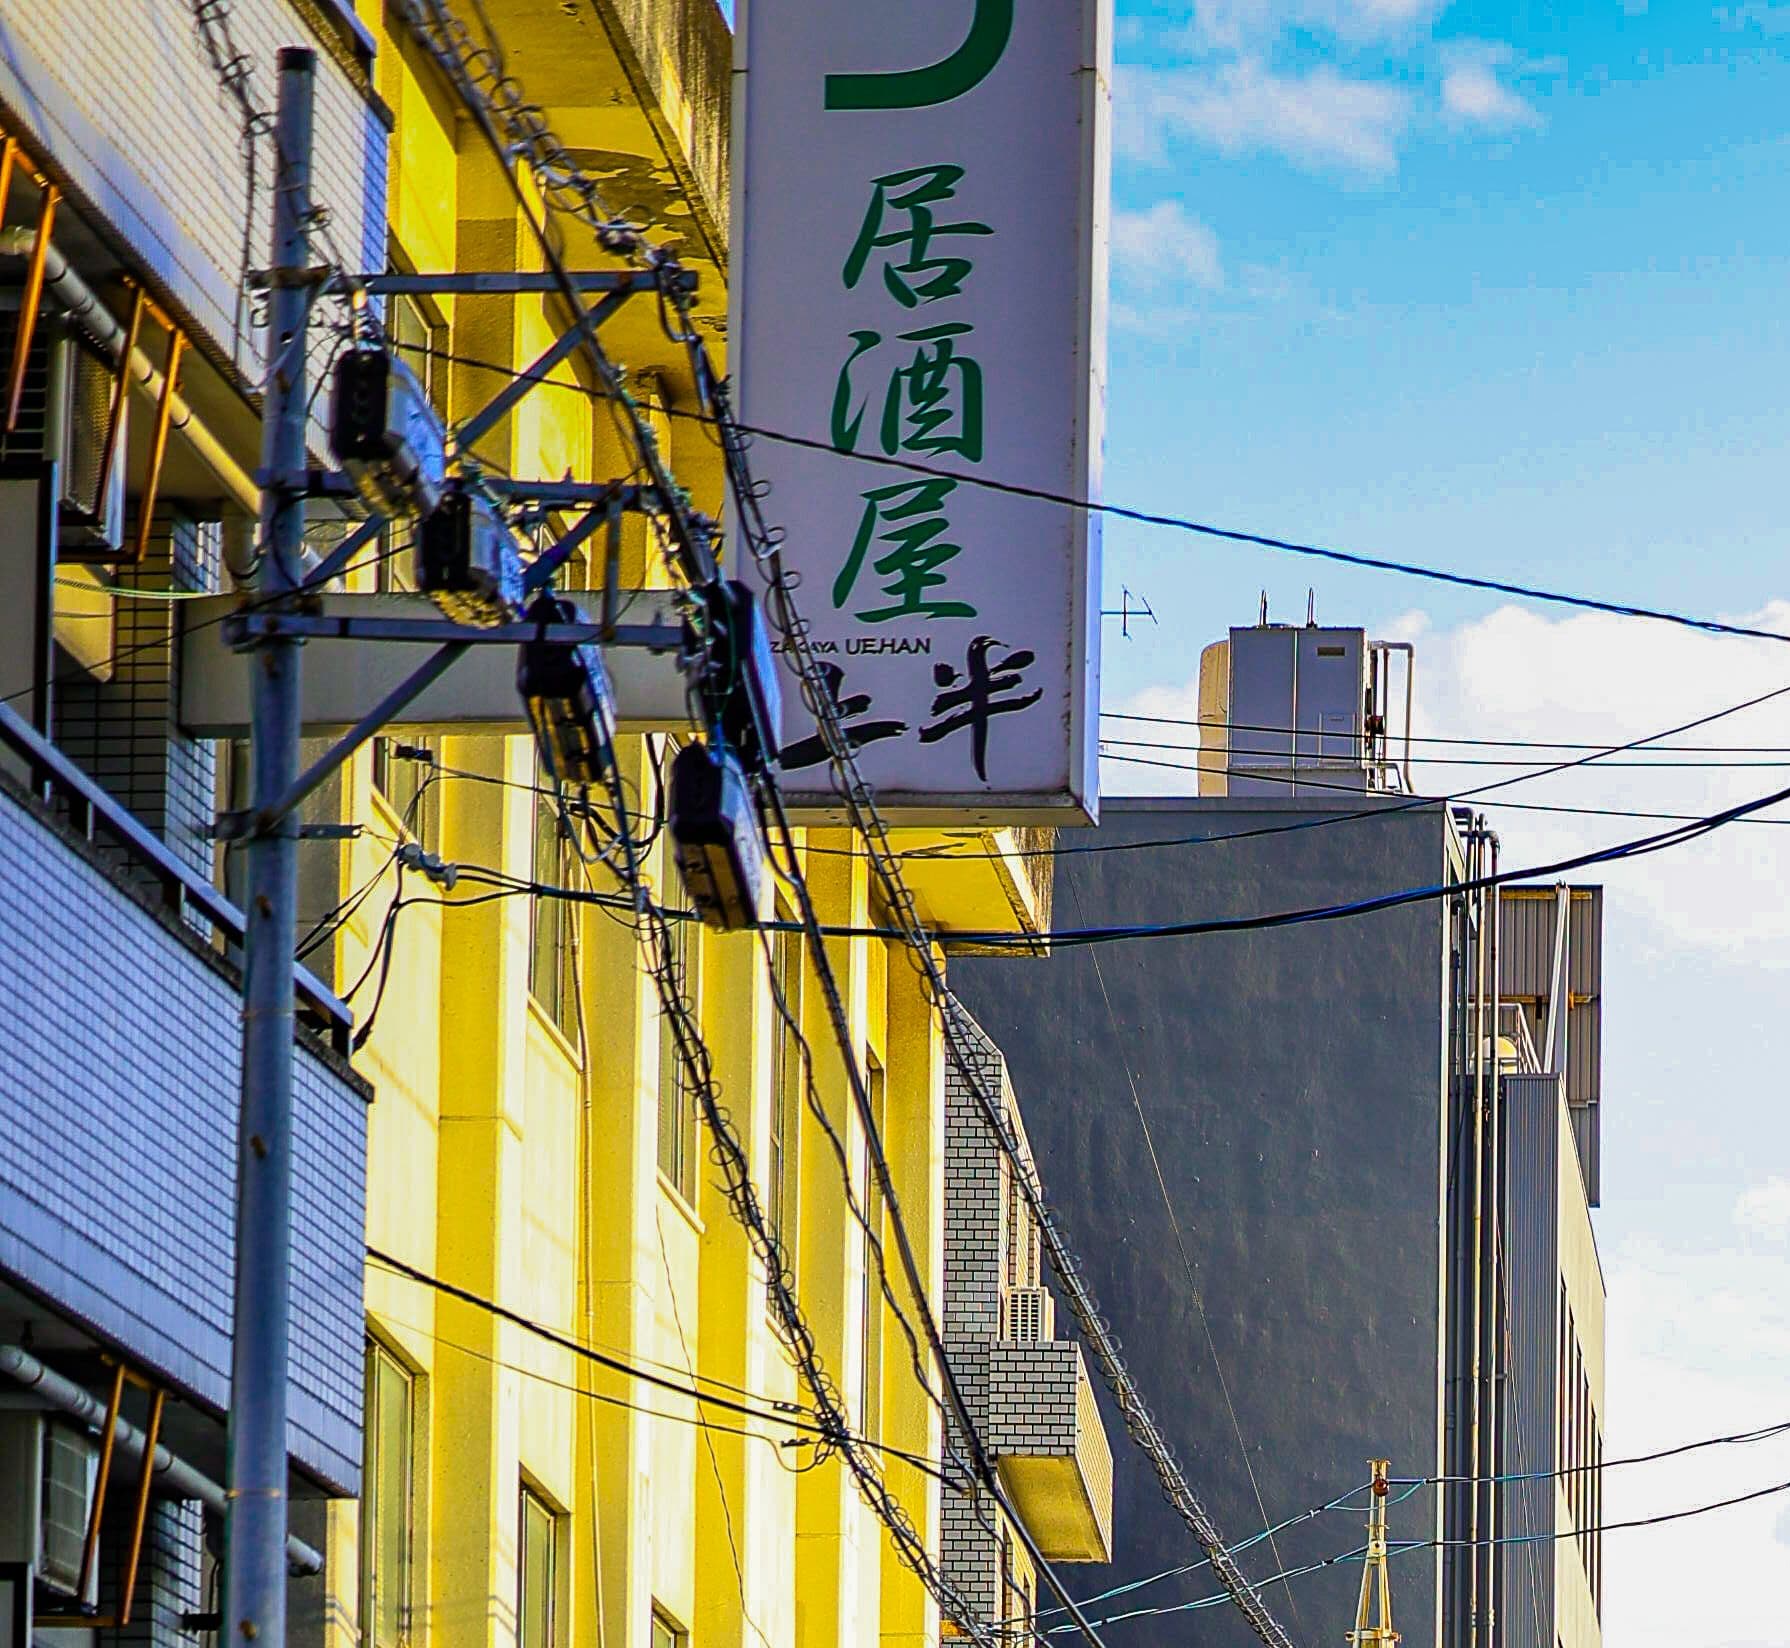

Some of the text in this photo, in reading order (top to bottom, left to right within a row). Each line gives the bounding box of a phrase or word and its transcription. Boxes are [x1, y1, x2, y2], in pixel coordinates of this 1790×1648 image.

[832, 164, 994, 623] 居酒屋
[777, 635, 1044, 785] 上半
[846, 637, 931, 654] UEHAN
